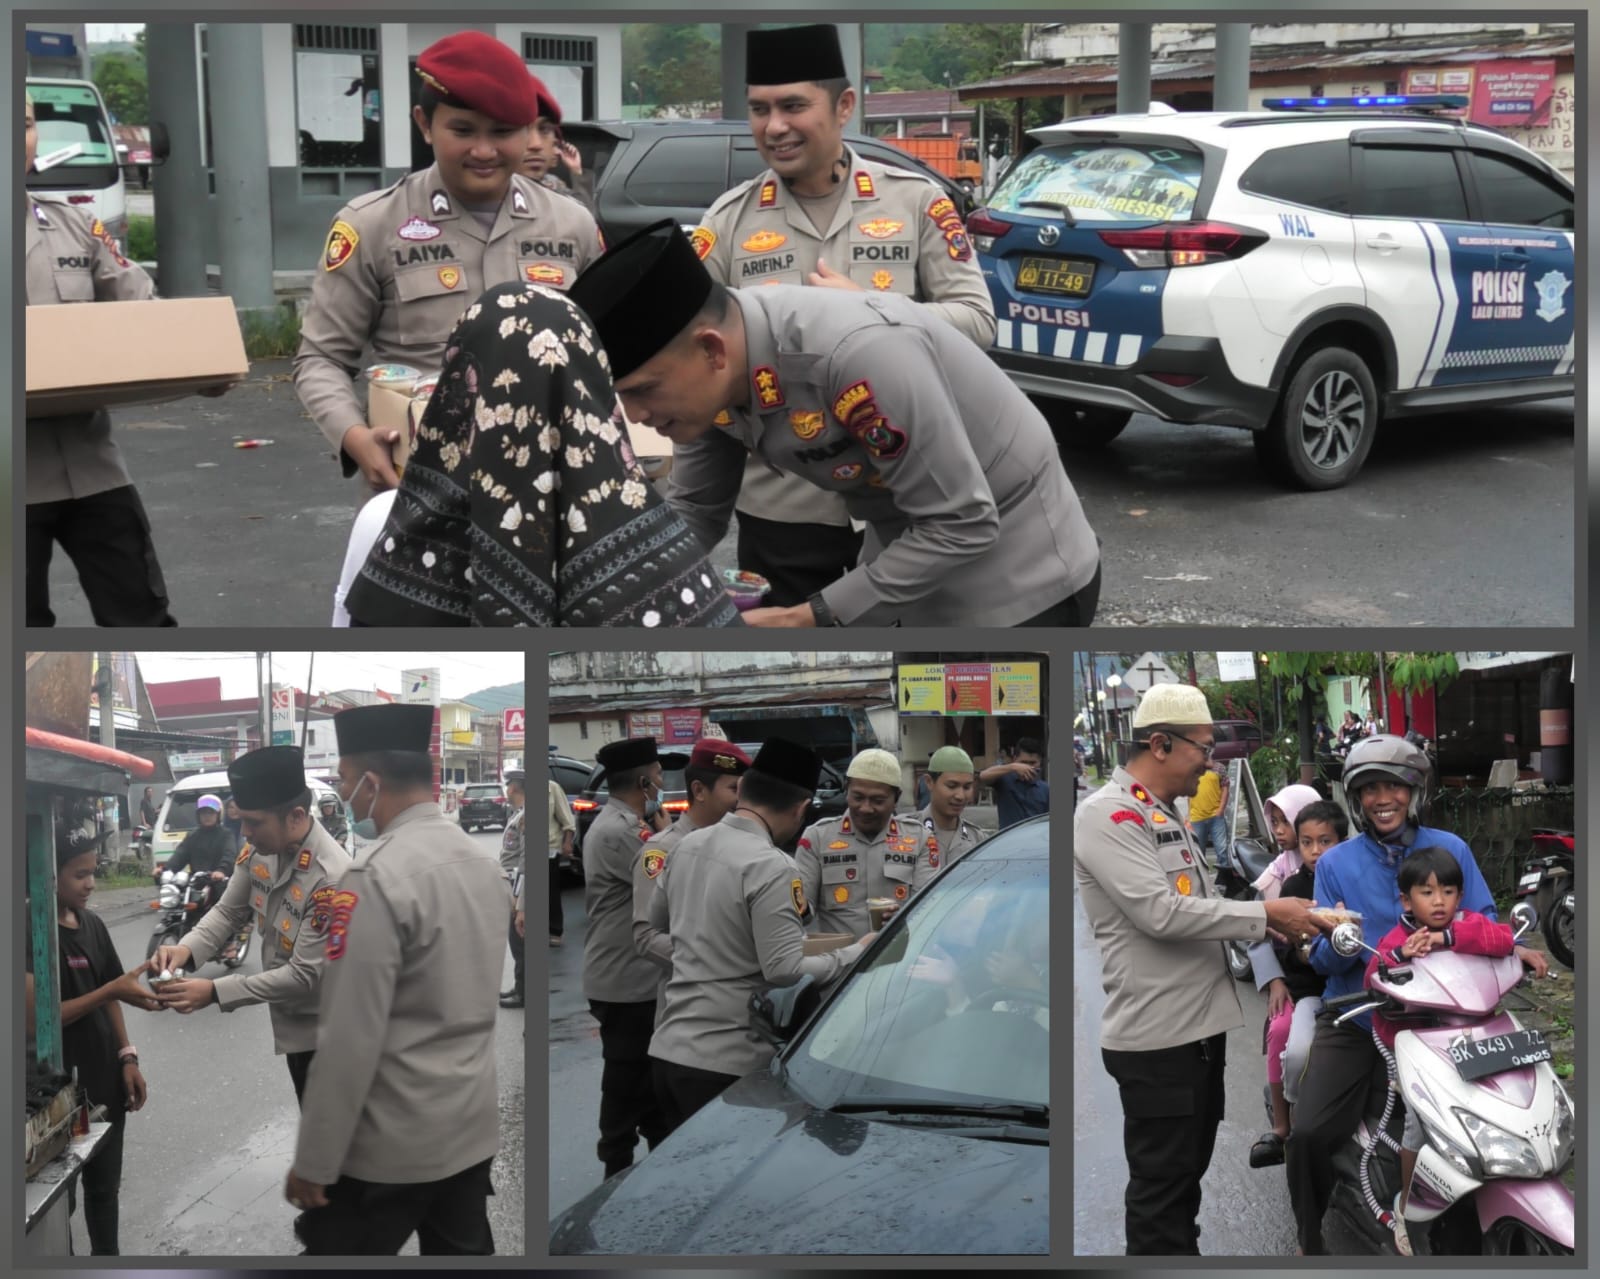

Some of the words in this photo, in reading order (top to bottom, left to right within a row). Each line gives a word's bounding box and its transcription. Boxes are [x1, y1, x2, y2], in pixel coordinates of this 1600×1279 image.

[1103, 197, 1177, 220] PRESISI
[1278, 212, 1316, 238] WAL
[394, 243, 455, 266] LAIYA
[520, 241, 573, 258] POLRI
[852, 246, 909, 261] POLRI
[741, 254, 795, 277] ARIFIN.P
[1042, 273, 1084, 291] 11-49
[1472, 271, 1526, 304] POLISI
[1008, 302, 1090, 328] POLISI
[1472, 305, 1493, 319] LALU
[1494, 305, 1523, 319] LINTAS
[884, 853, 917, 866] POLRI
[1475, 1035, 1514, 1056] 6491
[1419, 1159, 1453, 1193] HONDA
